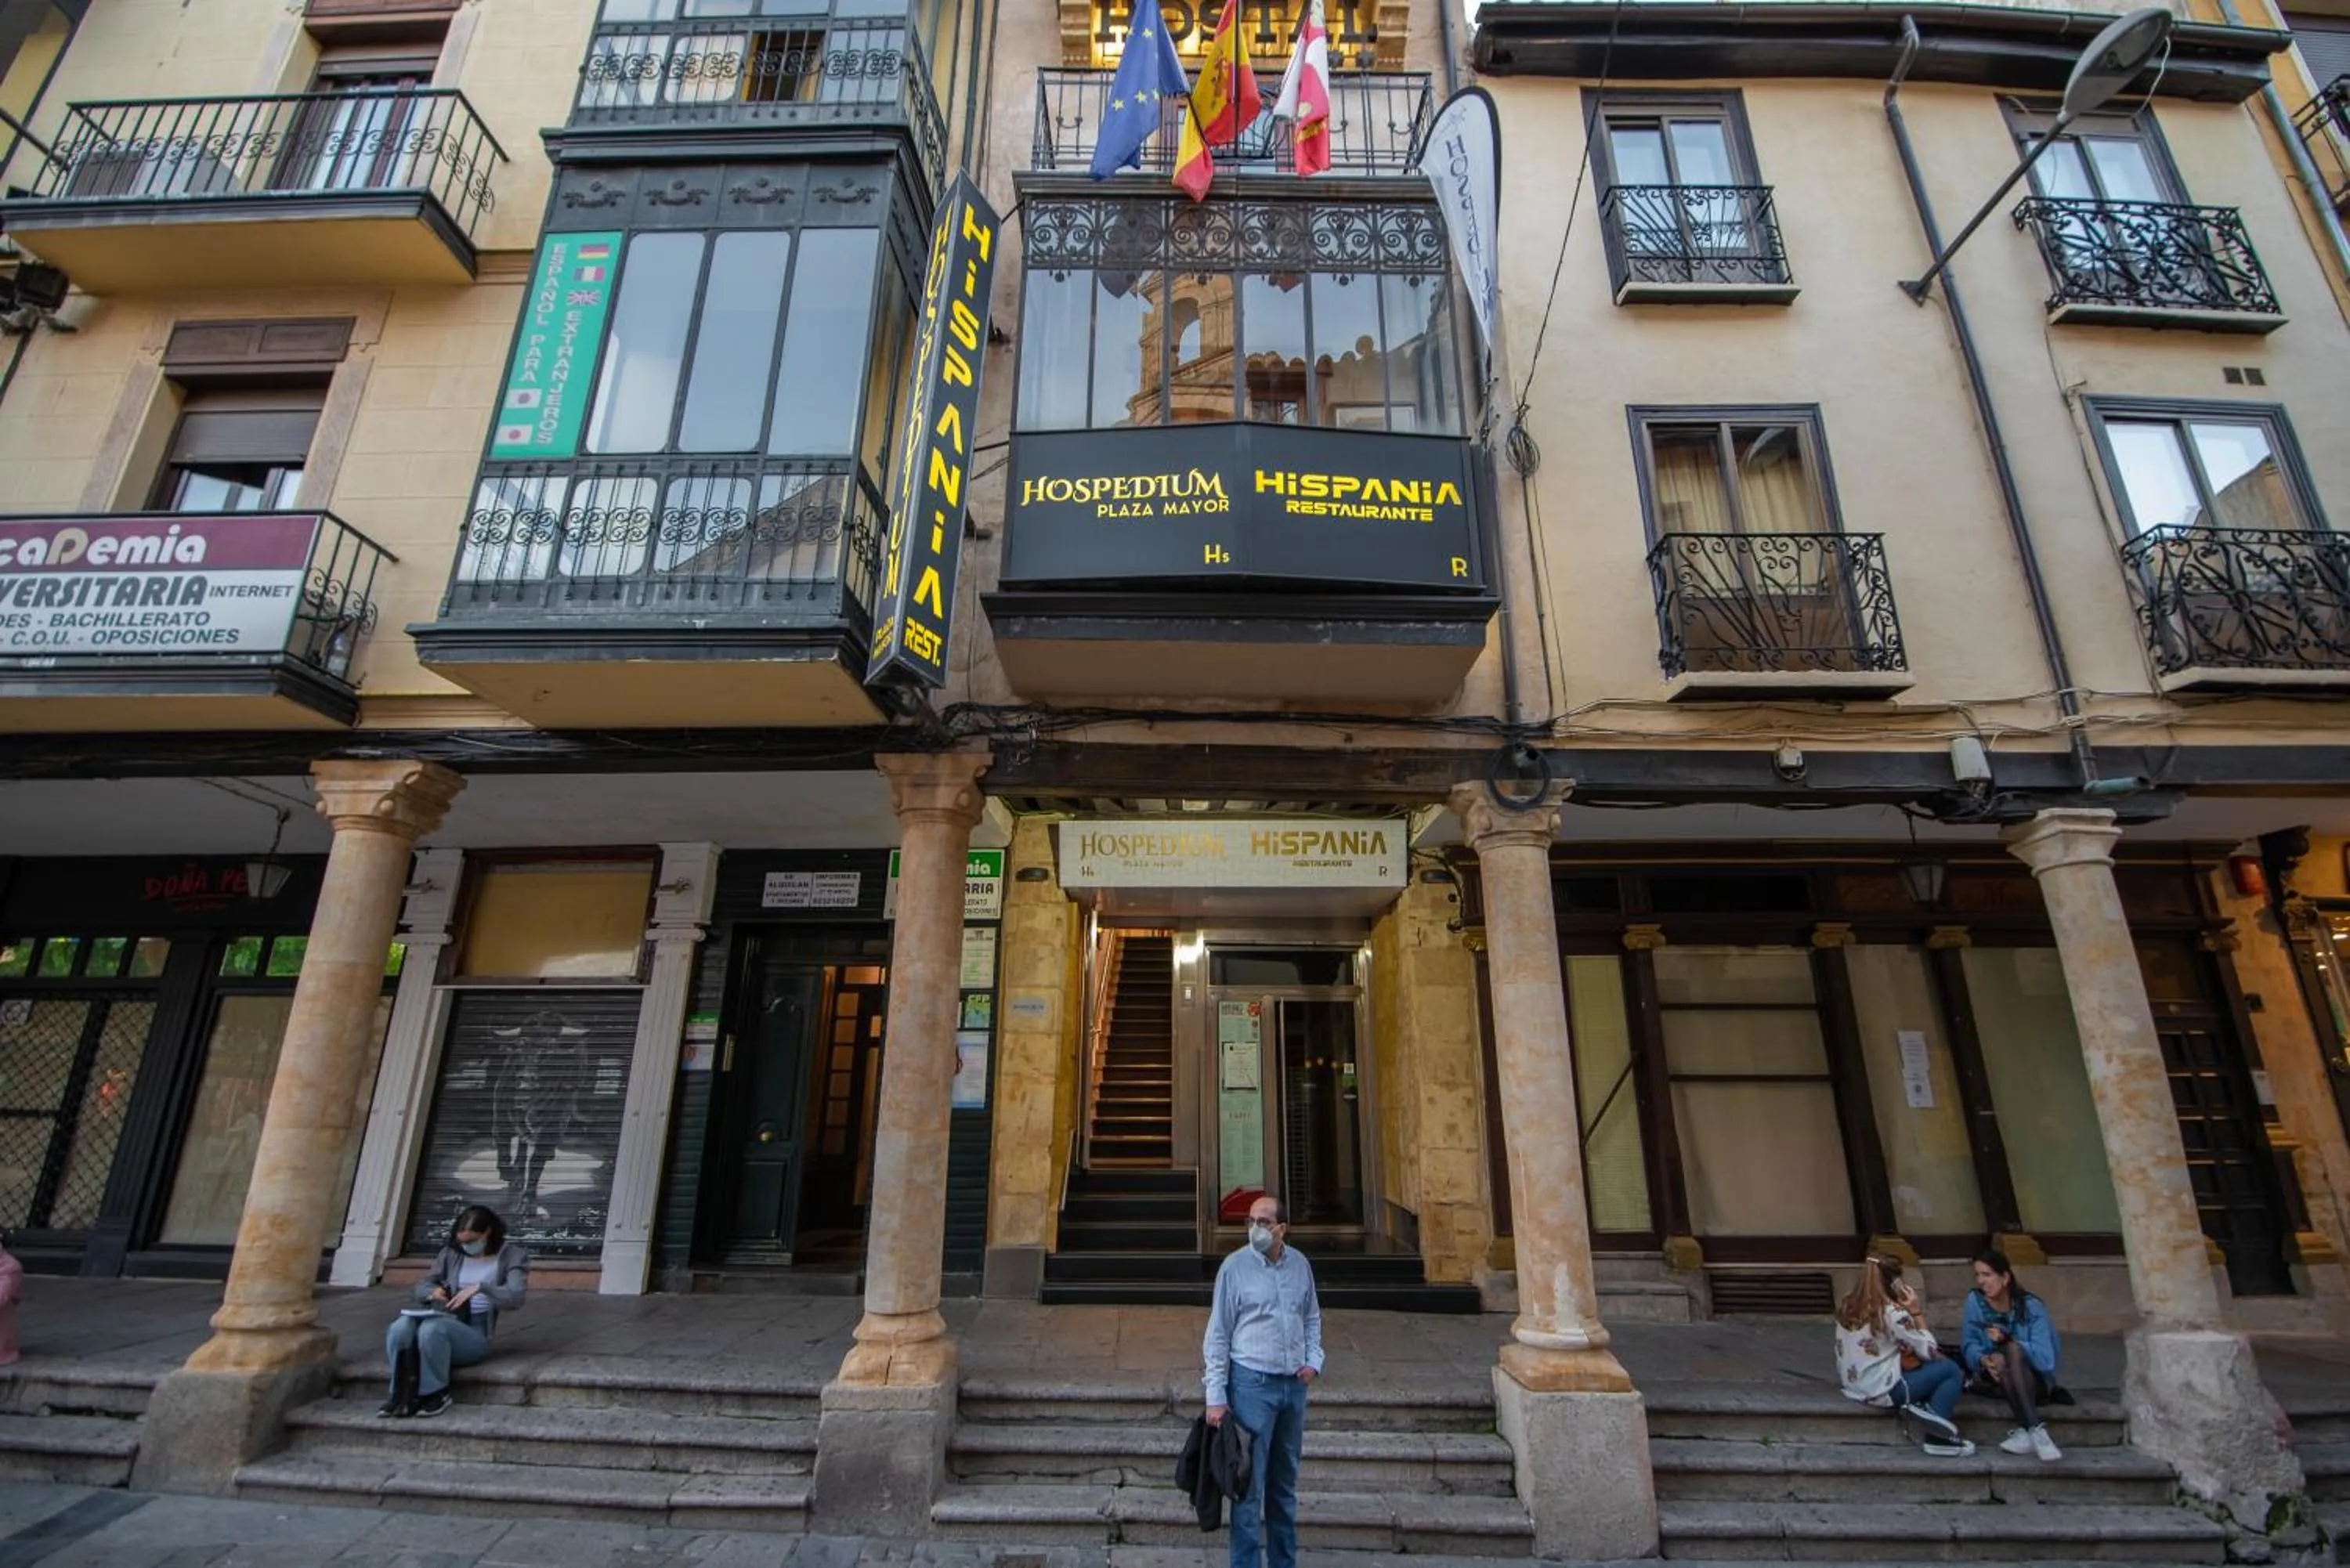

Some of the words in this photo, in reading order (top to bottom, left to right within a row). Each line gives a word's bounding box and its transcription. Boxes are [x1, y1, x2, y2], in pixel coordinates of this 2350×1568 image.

[520, 334, 545, 382] PARA
[537, 310, 582, 445] EXTRANJEROS
[1021, 468, 1229, 507] HOSPEDIUM
[1097, 503, 1154, 518] PLAZA
[1163, 499, 1229, 515] MAYOR
[1285, 500, 1434, 522] RESTAURANTE
[1204, 544, 1230, 564] Hs
[1452, 556, 1468, 577] R
[209, 585, 295, 598] INTERNET
[49, 611, 211, 628] BACHILLERATO
[11, 630, 70, 645] C.O.U.
[91, 628, 240, 645] OPOSICIONES
[904, 616, 942, 667] REST.
[1081, 830, 1227, 860] HOSPEDIUM
[219, 868, 248, 893] PE
[1379, 865, 1388, 877] R
